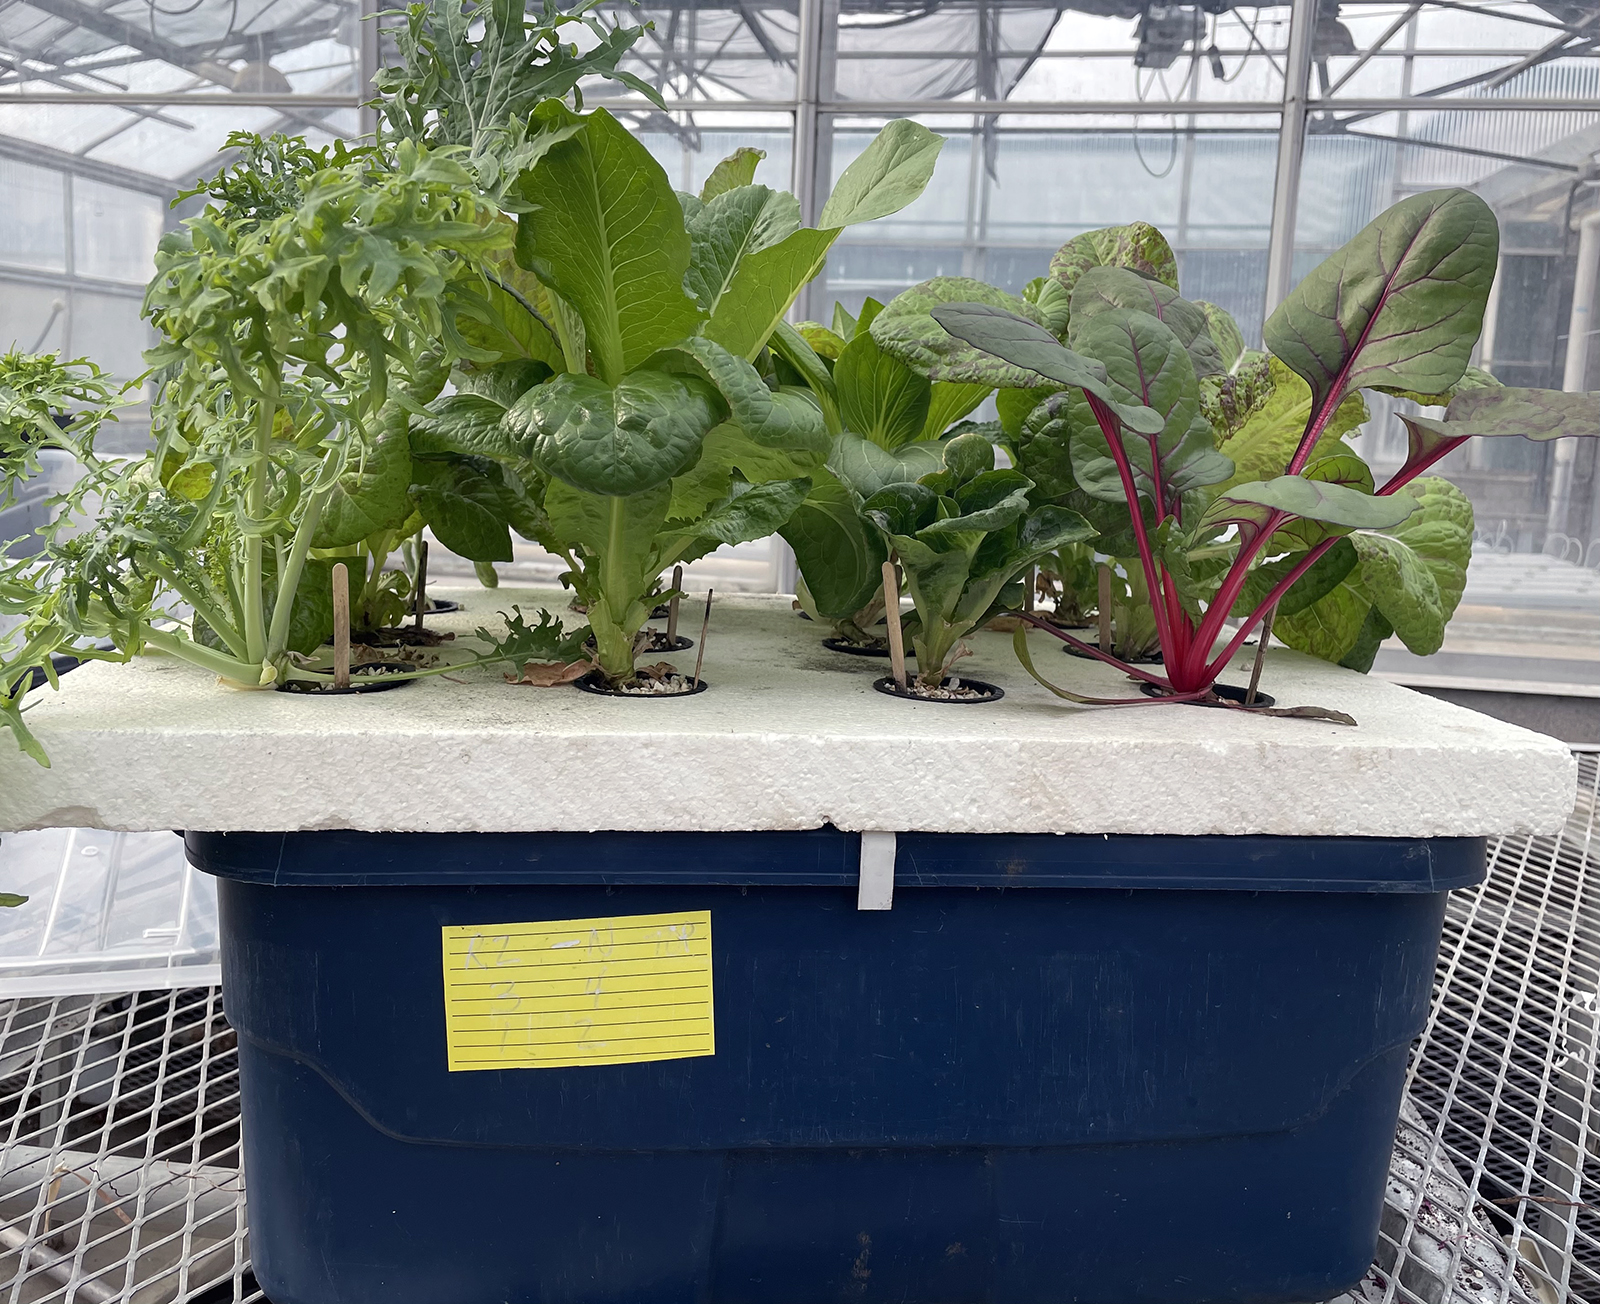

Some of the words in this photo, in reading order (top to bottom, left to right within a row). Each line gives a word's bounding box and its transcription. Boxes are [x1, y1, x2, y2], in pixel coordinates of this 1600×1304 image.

[489, 980, 521, 1014] 3
[585, 965, 608, 1010] 4
[574, 1017, 607, 1050] 2
